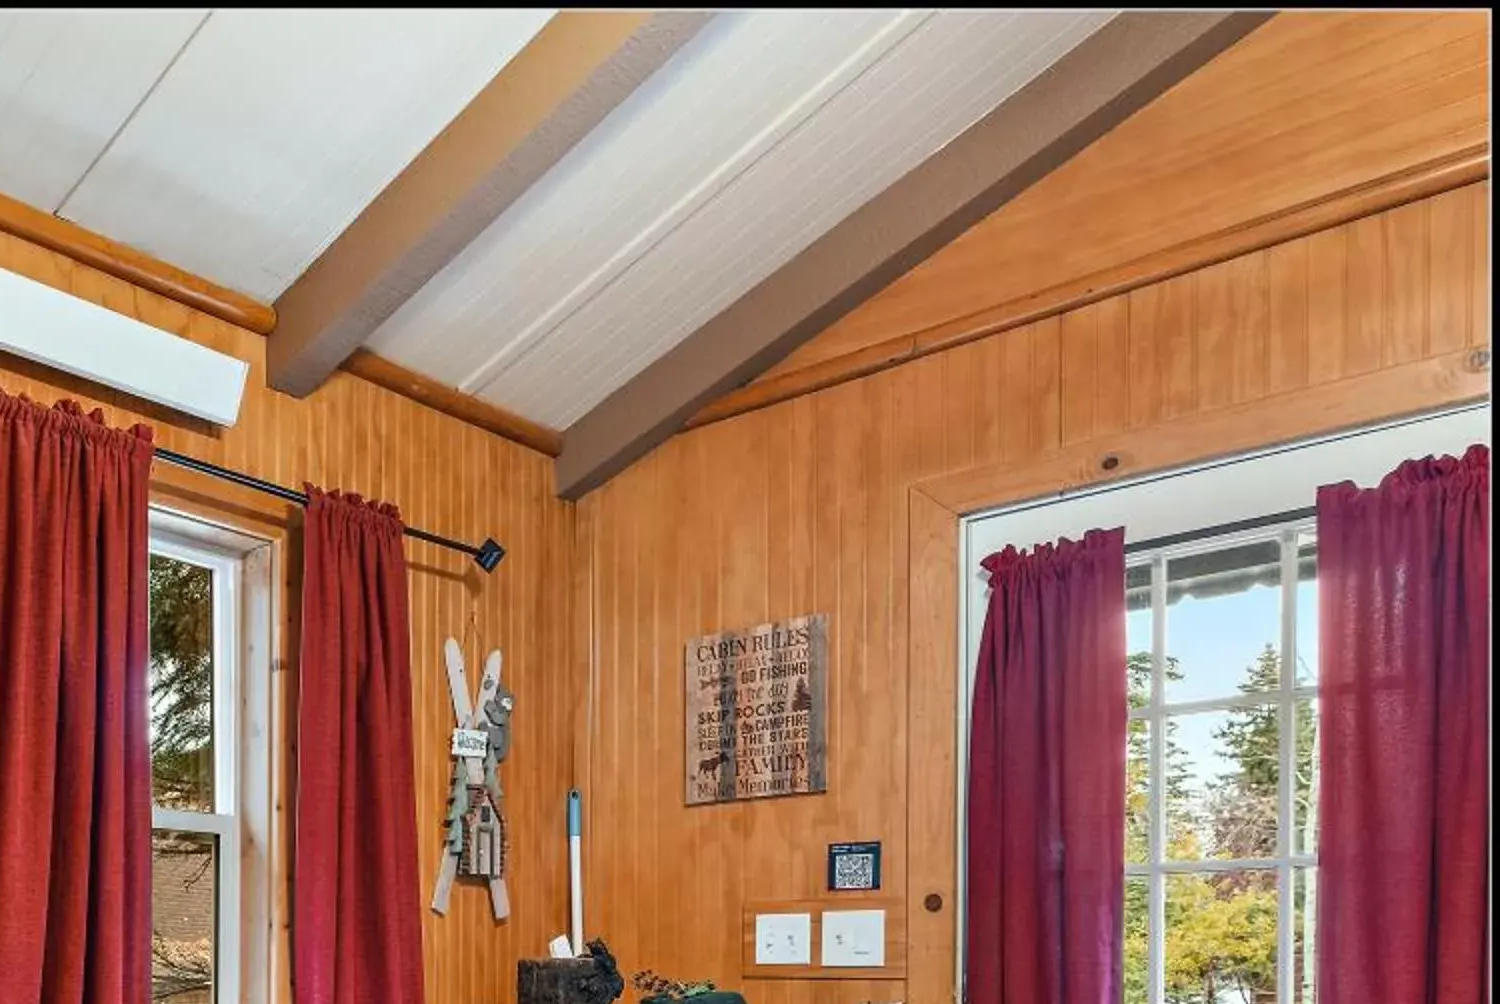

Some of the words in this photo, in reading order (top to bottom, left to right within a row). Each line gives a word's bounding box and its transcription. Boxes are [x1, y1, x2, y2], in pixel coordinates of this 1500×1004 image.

[697, 638, 747, 662] CABIN
[752, 627, 810, 652] RULES
[741, 668, 756, 684] GO
[759, 662, 807, 682] FISHING
[698, 709, 729, 725] SKIP
[735, 701, 785, 719] ROCKS
[755, 714, 810, 733] CAMPFIRE
[742, 733, 764, 746] THE
[769, 728, 808, 743] STARS
[735, 754, 806, 777] FAMILY
